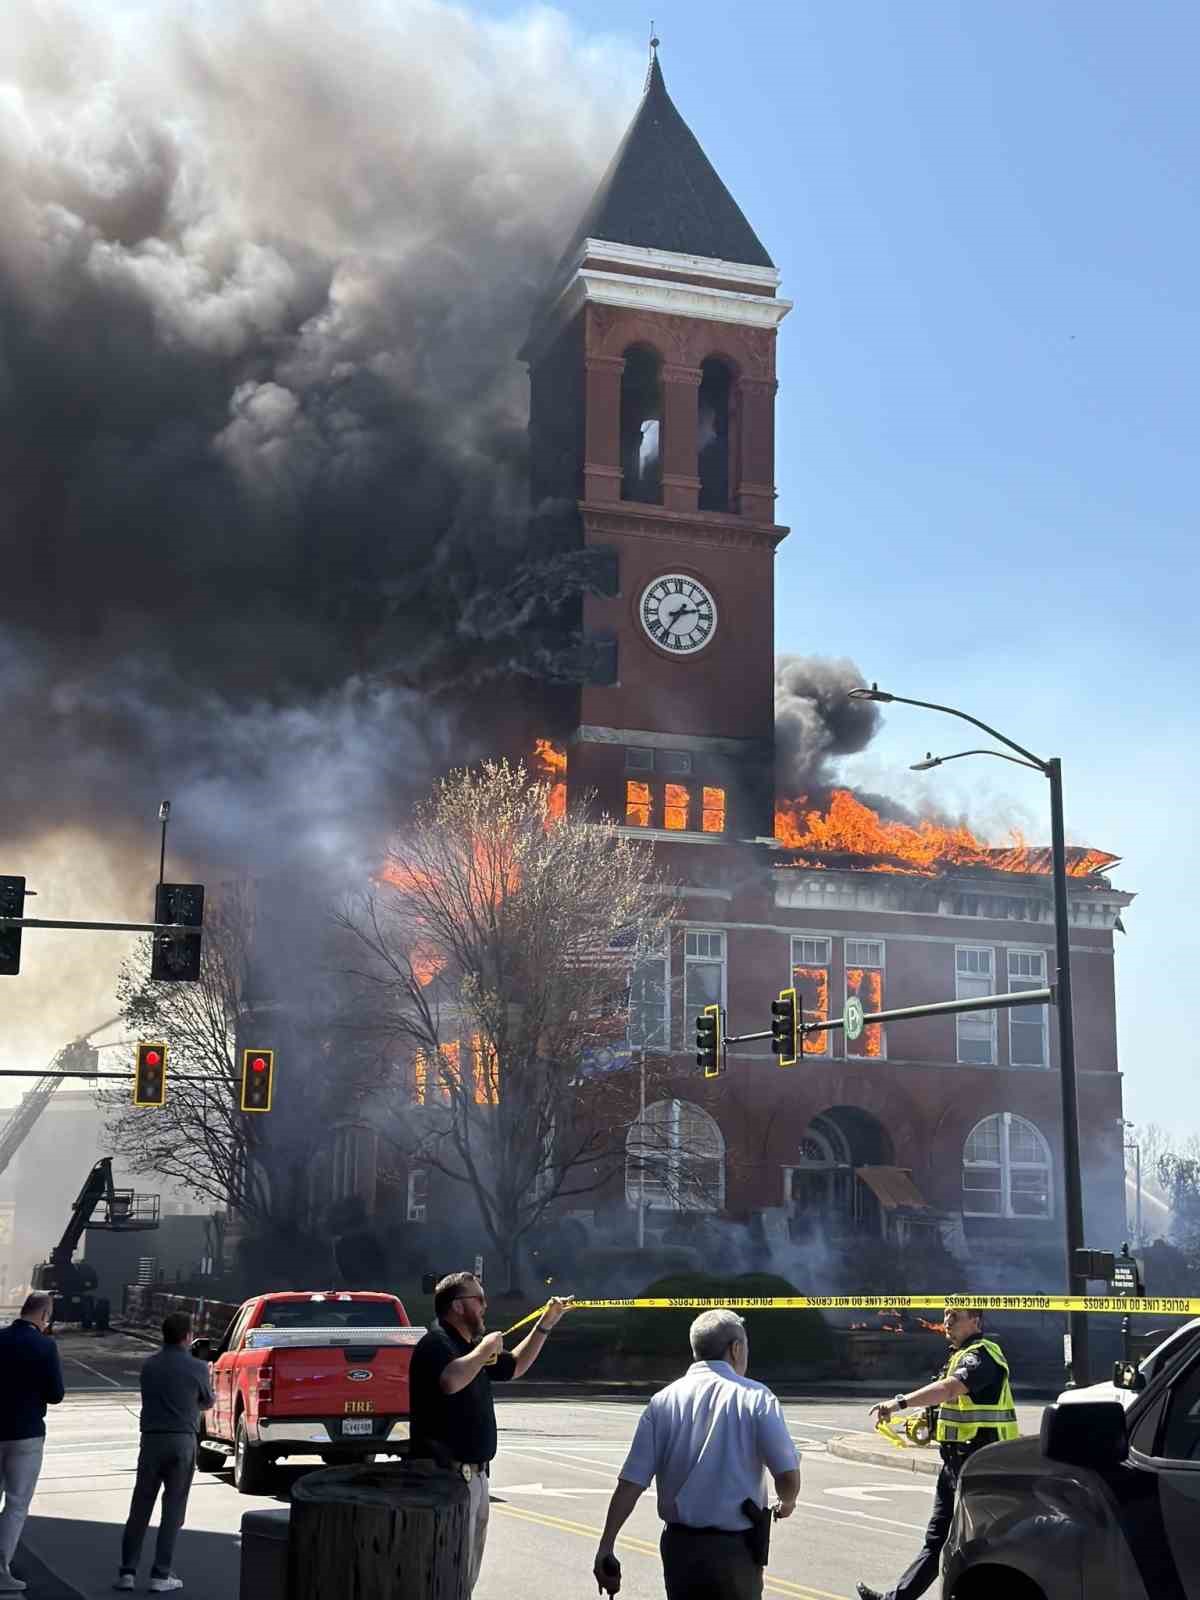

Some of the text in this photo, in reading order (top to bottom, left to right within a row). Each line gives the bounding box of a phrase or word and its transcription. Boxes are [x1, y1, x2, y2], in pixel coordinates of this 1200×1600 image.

[669, 1298, 694, 1306] CROSS
[696, 1298, 711, 1306] NOT
[727, 1298, 744, 1306] LINE
[745, 1298, 773, 1306] POLICE
[807, 1296, 911, 1306] POLICE LINE DO NOT CROSS
[944, 1296, 1050, 1308] POLICE LINE DO NOT CROSS
[1083, 1298, 1190, 1312] POLICE LINE DO NOT CROSS
[344, 1401, 374, 1413] FIRE
